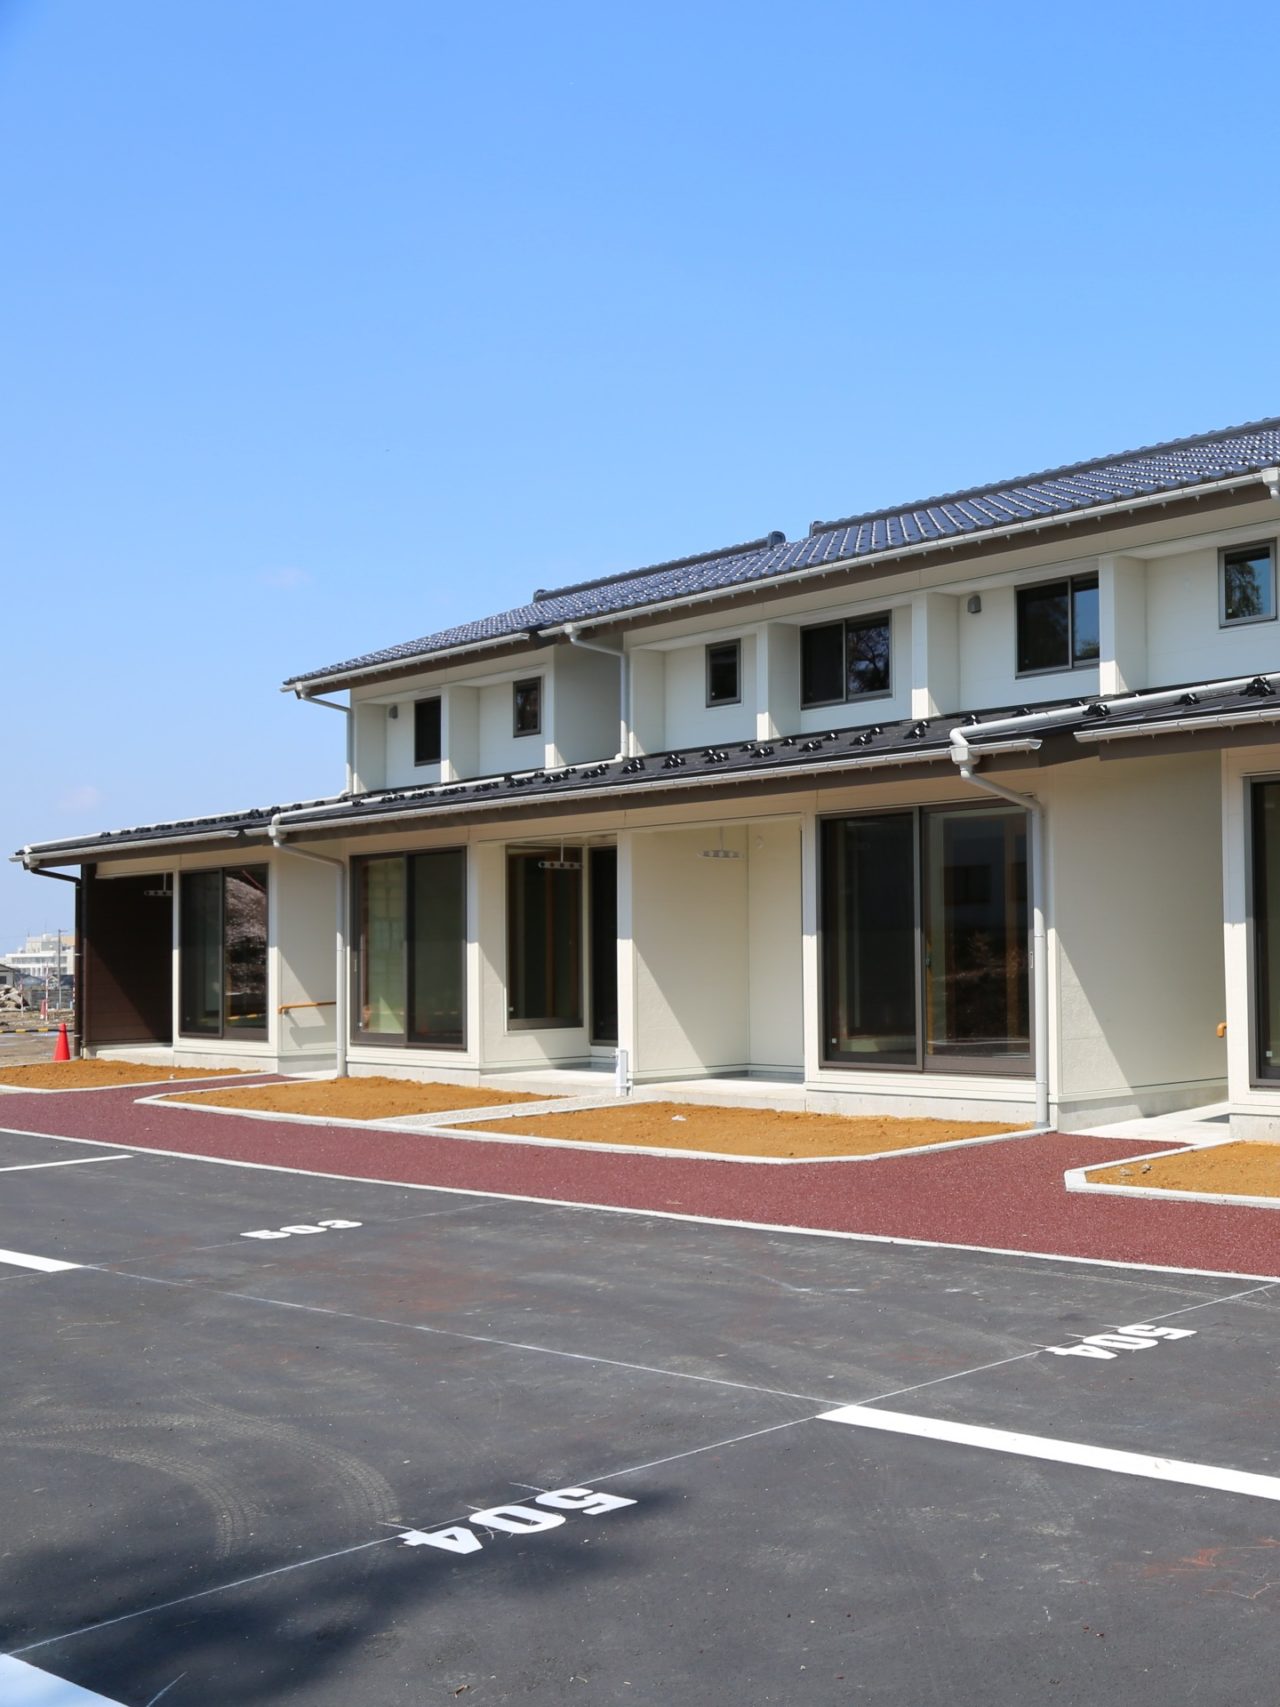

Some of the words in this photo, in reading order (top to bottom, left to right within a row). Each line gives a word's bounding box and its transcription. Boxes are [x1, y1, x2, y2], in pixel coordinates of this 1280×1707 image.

[239, 1219, 363, 1239] 503
[1045, 1324, 1198, 1360] 504
[398, 1487, 639, 1555] 504
